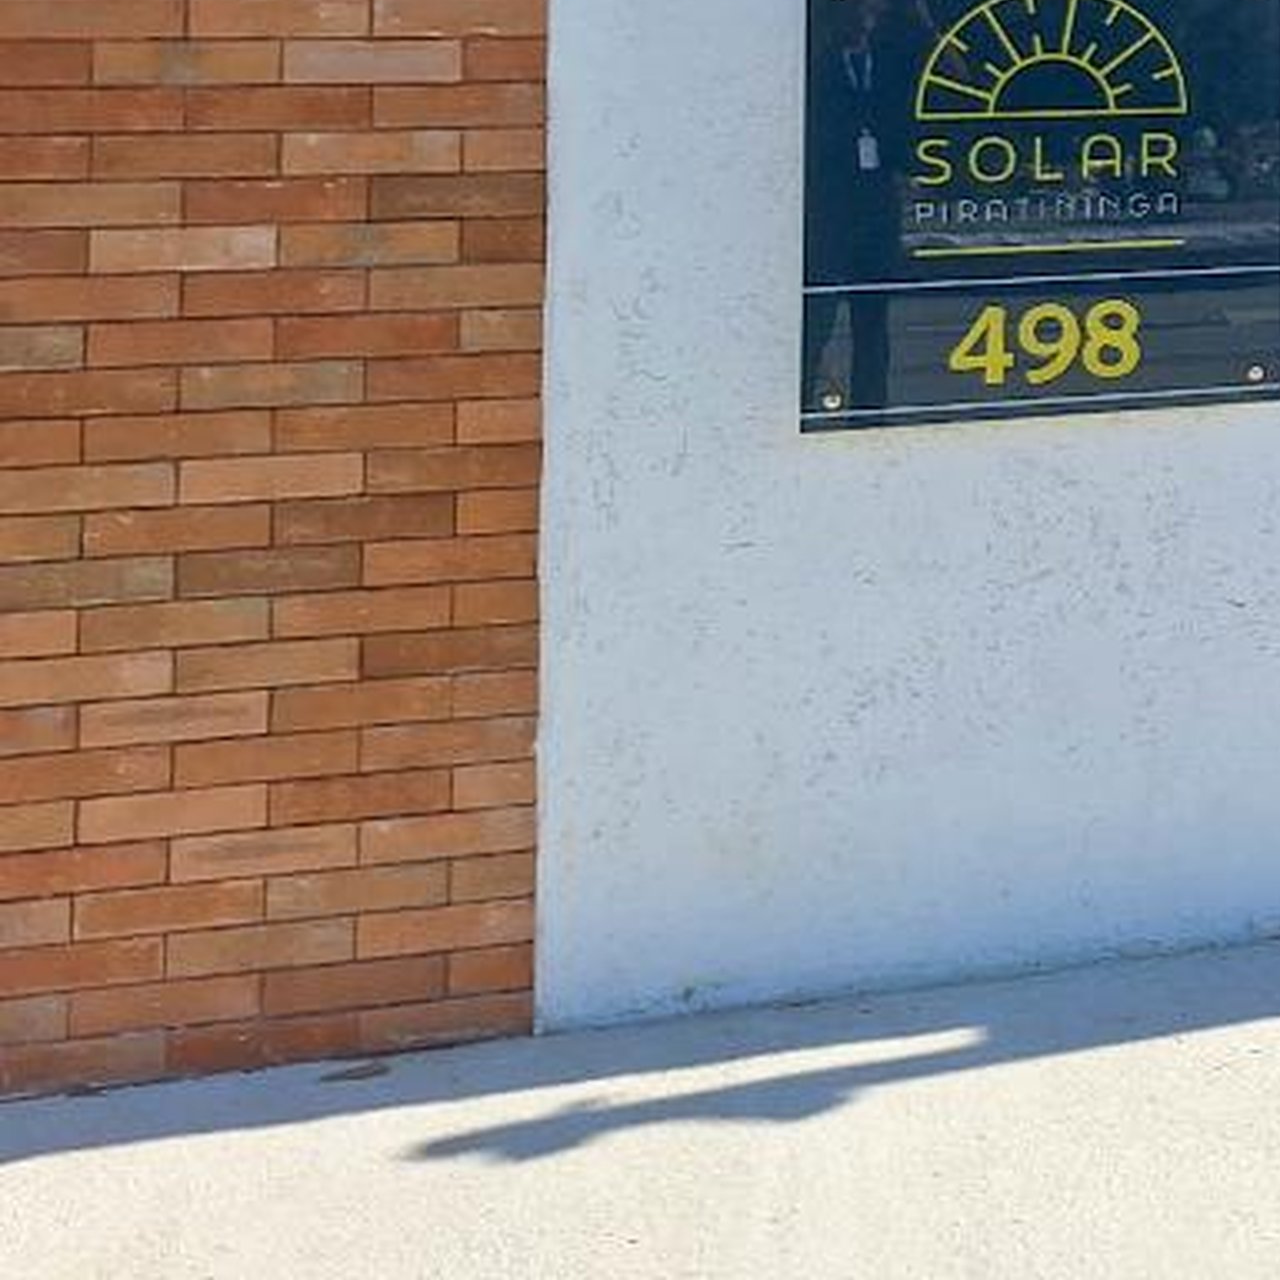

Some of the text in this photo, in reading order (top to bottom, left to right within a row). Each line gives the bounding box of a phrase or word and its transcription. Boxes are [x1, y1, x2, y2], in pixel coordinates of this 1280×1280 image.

[913, 133, 1178, 186] SOLAR
[914, 192, 1180, 224] PIRATININGA
[948, 299, 1142, 386] 498
